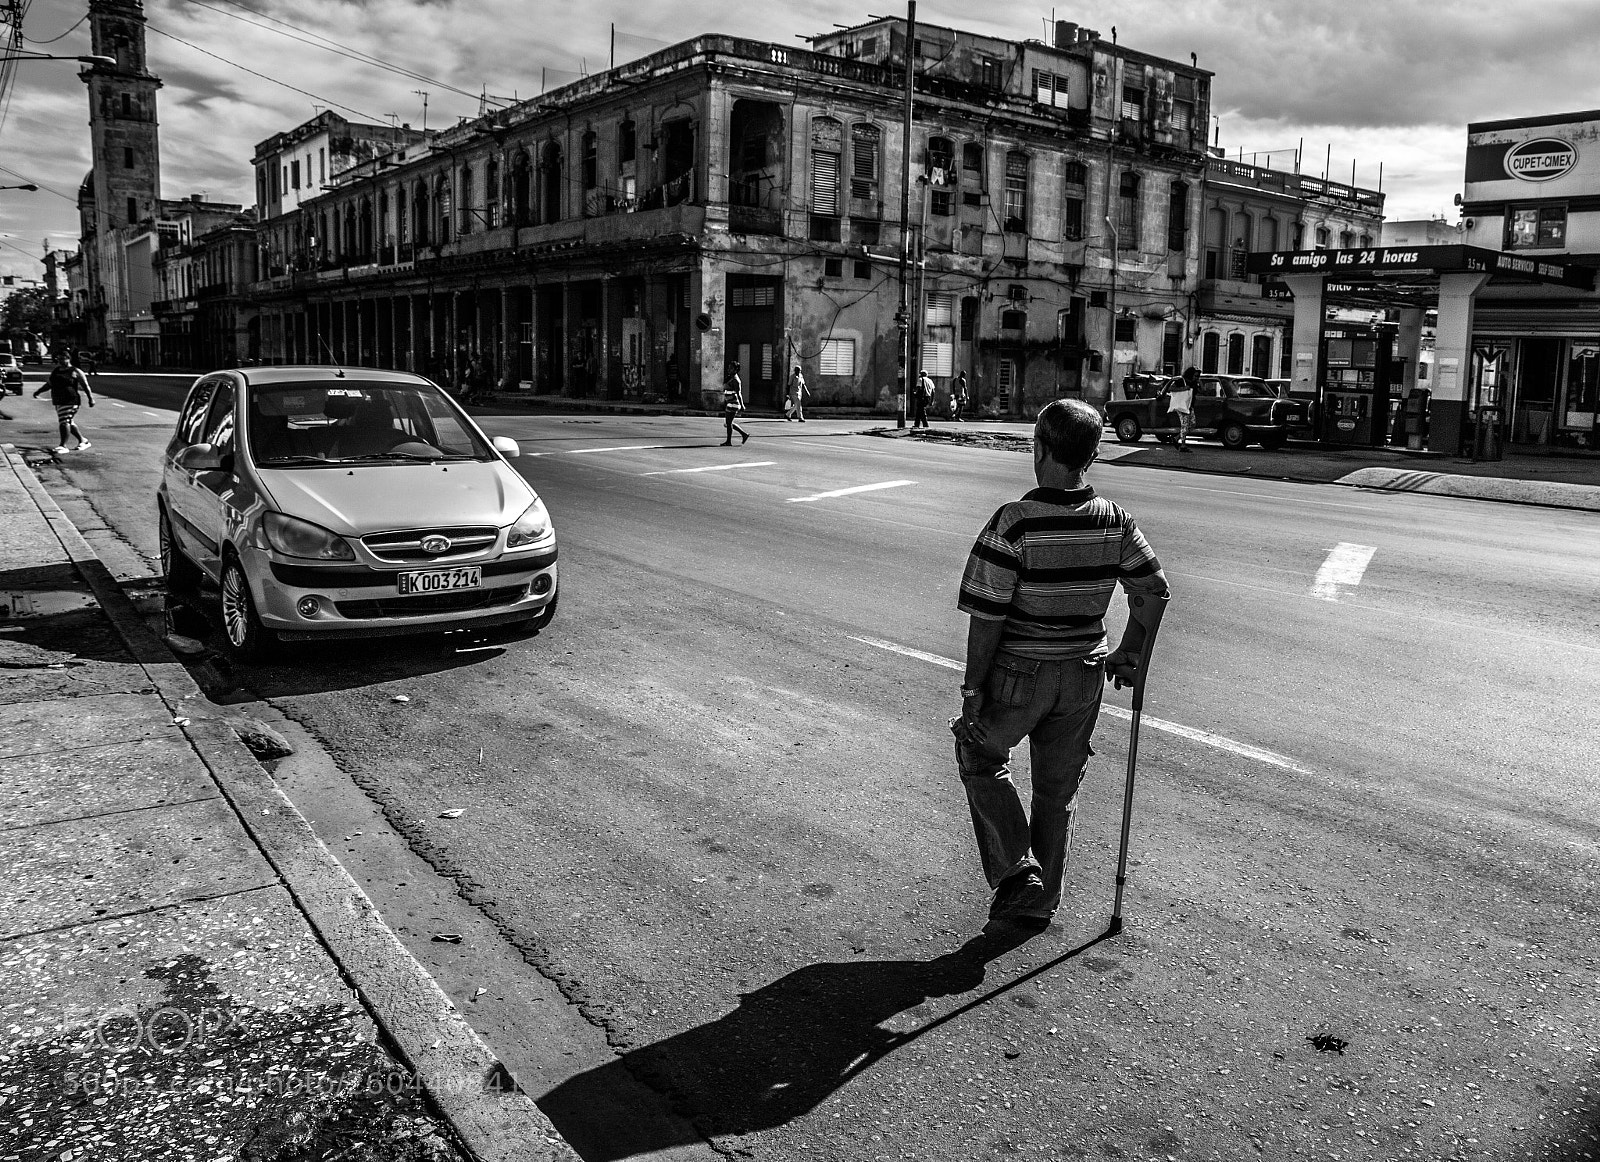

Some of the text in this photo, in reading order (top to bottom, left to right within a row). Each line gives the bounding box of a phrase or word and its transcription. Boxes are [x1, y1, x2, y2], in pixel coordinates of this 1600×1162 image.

[1513, 154, 1572, 170] CUPET-CIMEX
[1270, 250, 1419, 268] Su amigo las 24 horas
[1496, 255, 1512, 270] AUTO
[1512, 258, 1535, 273] SERVICIO
[1326, 283, 1352, 292] RVICIO
